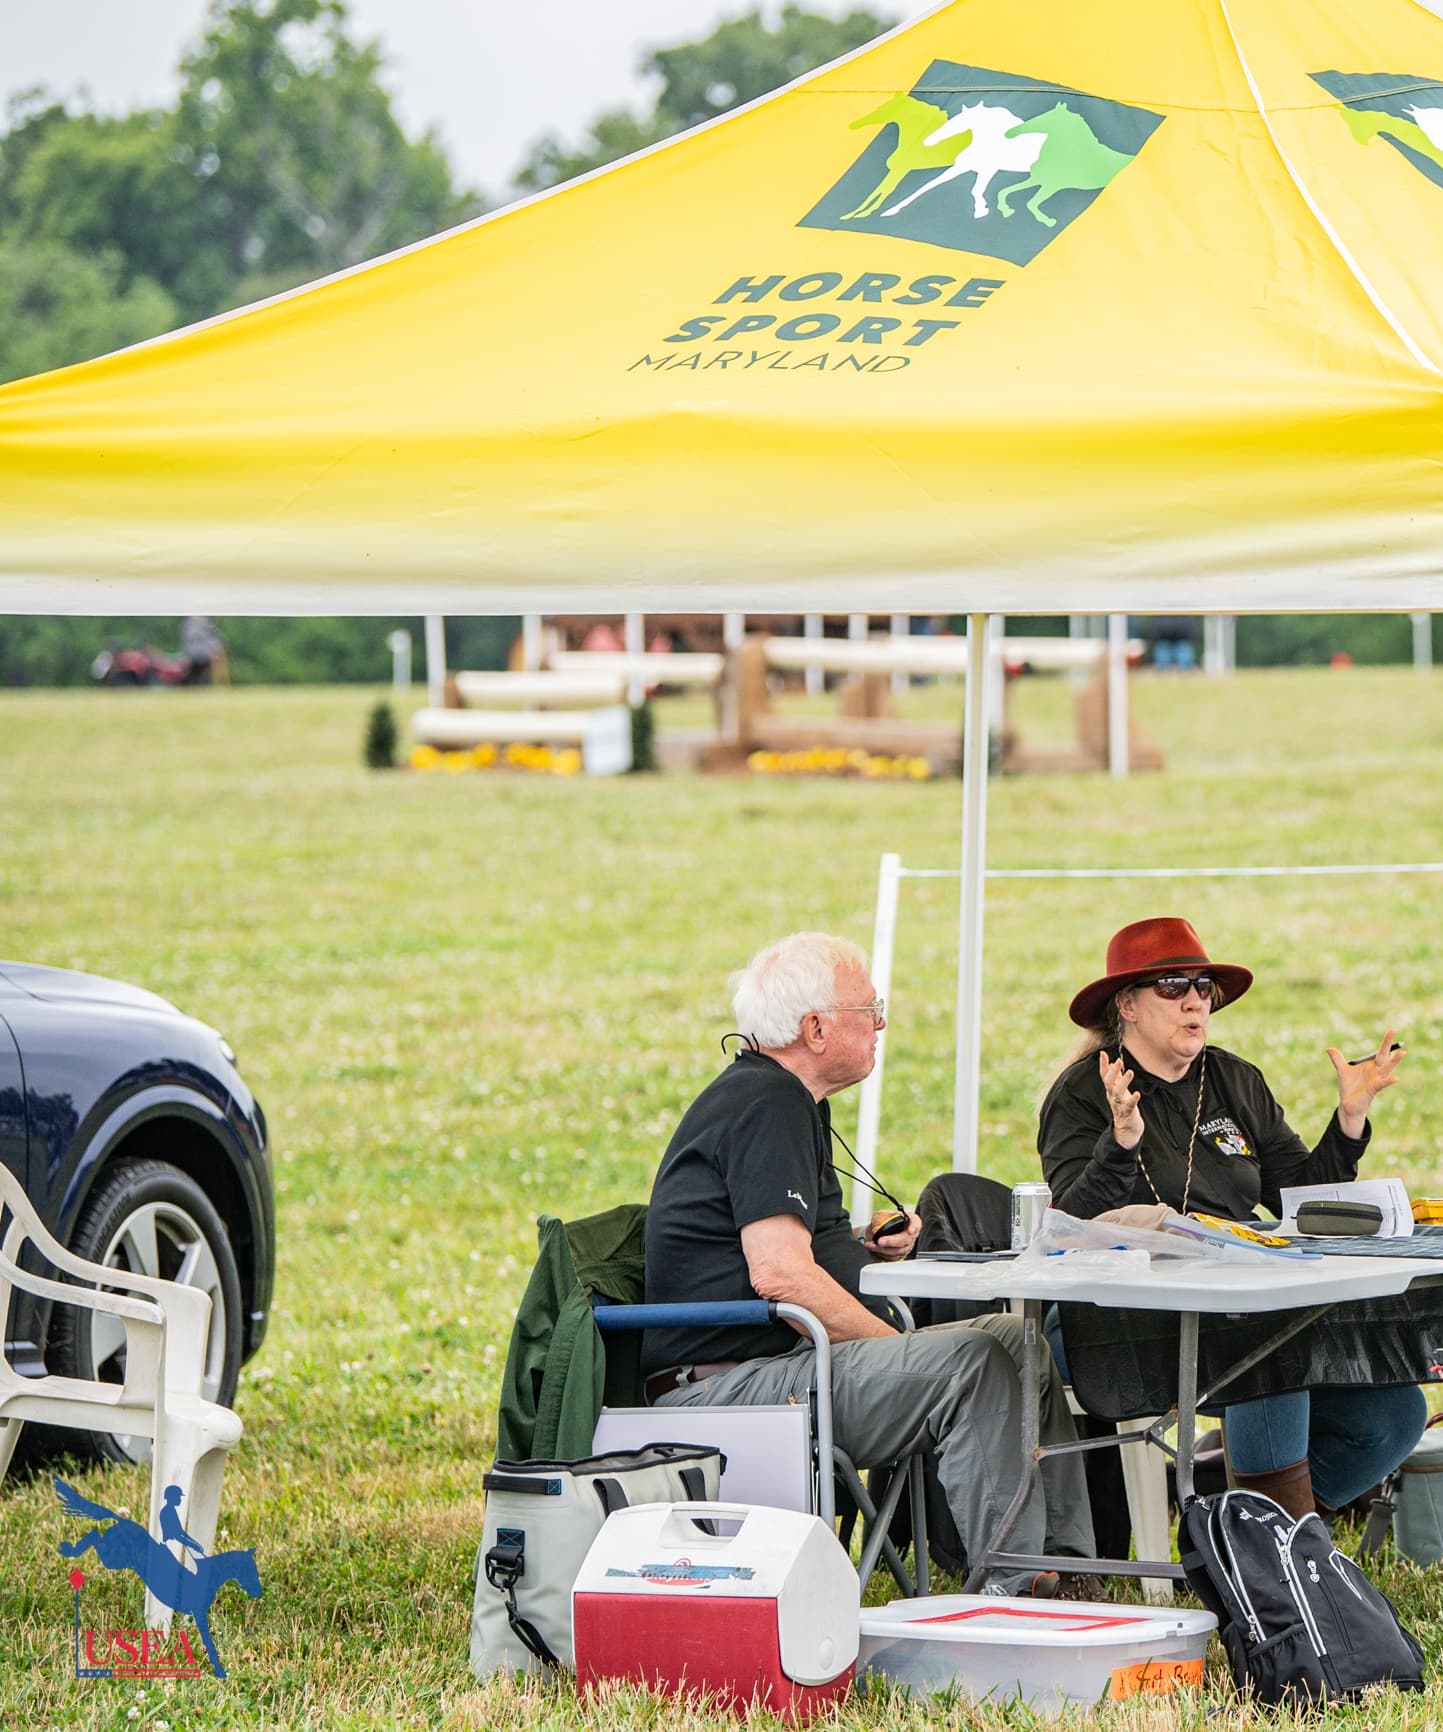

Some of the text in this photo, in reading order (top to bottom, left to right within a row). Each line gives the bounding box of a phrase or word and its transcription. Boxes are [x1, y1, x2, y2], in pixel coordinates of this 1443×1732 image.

[712, 272, 1006, 308] HORSE
[663, 313, 961, 346] SPORT
[626, 350, 911, 373] MARYLAND
